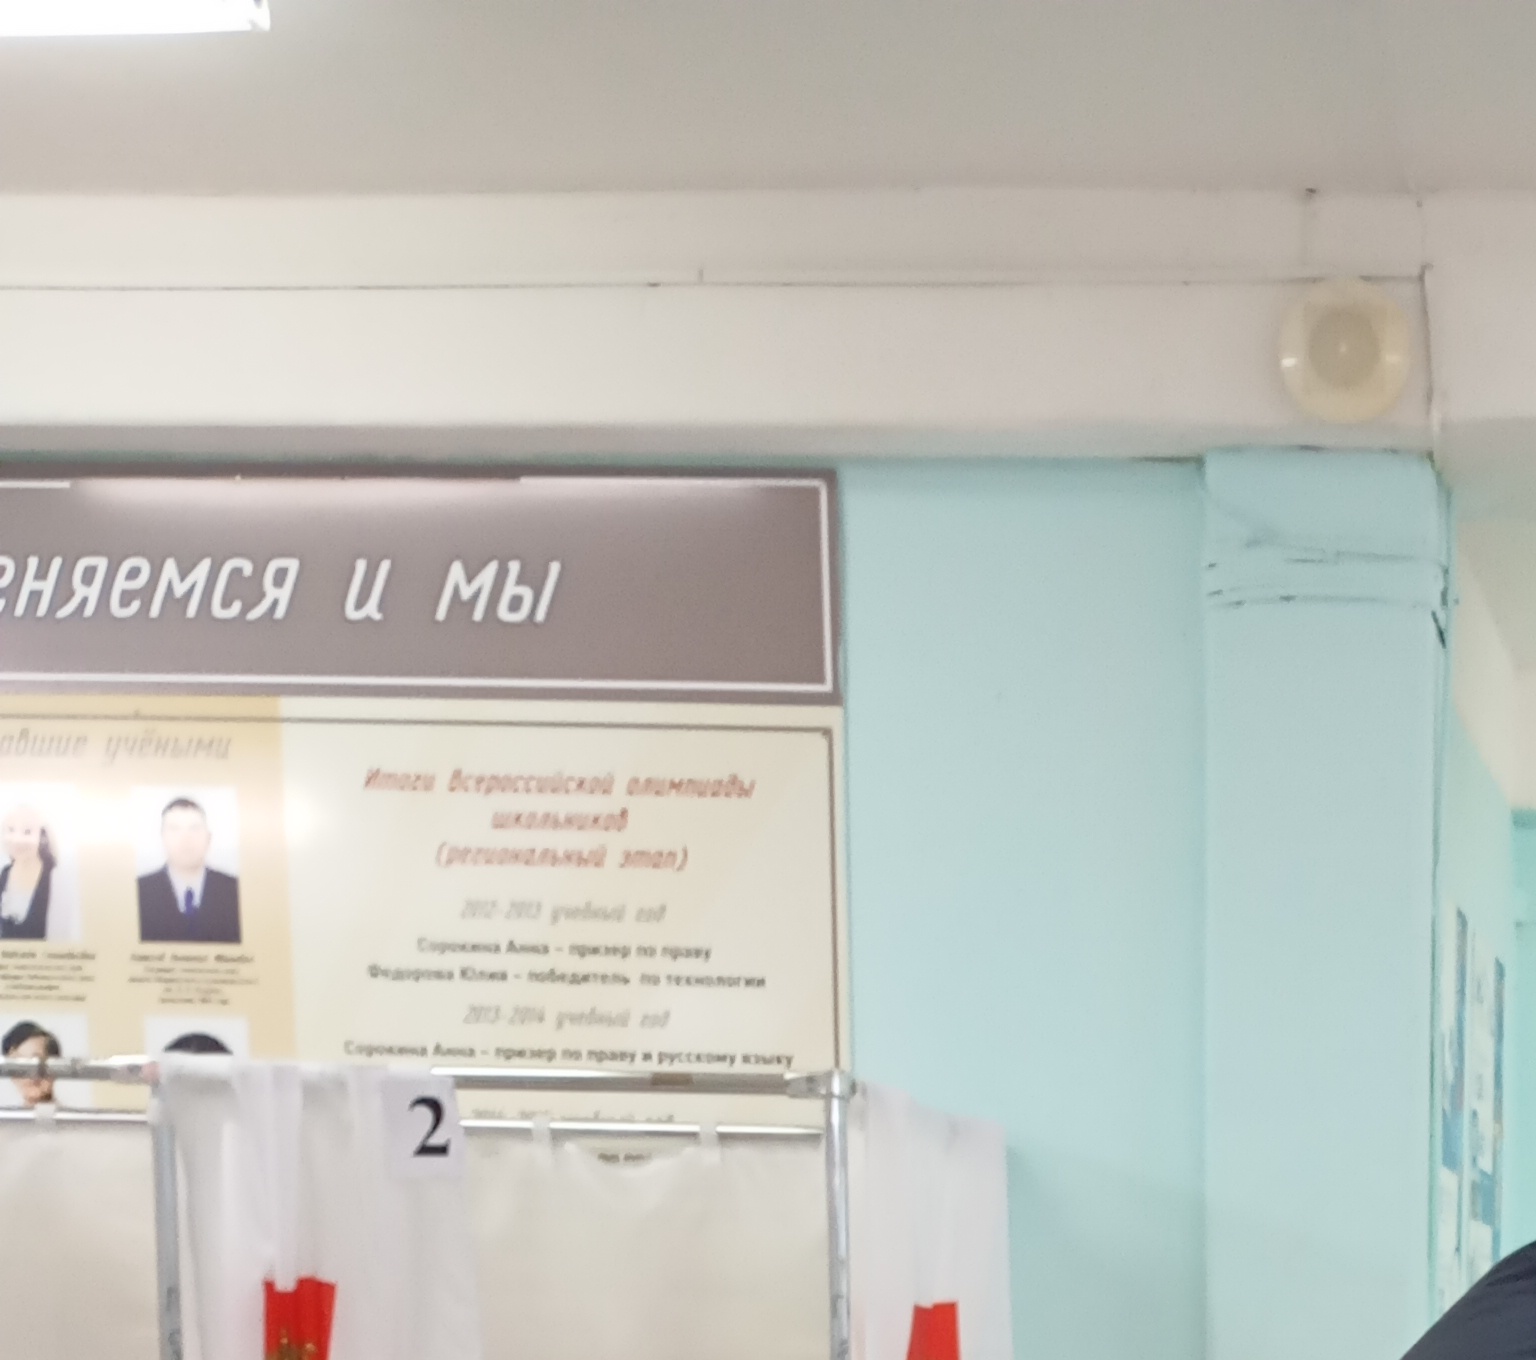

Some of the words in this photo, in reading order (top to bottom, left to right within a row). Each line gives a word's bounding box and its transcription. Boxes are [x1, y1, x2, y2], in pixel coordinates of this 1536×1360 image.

[344, 558, 392, 623] и
[434, 560, 561, 624] мы
[364, 768, 436, 792] Итоги
[448, 768, 615, 796] Всероссийской
[626, 773, 756, 798] олимпиады
[491, 807, 628, 832] школьников
[409, 1096, 451, 1157] 2
